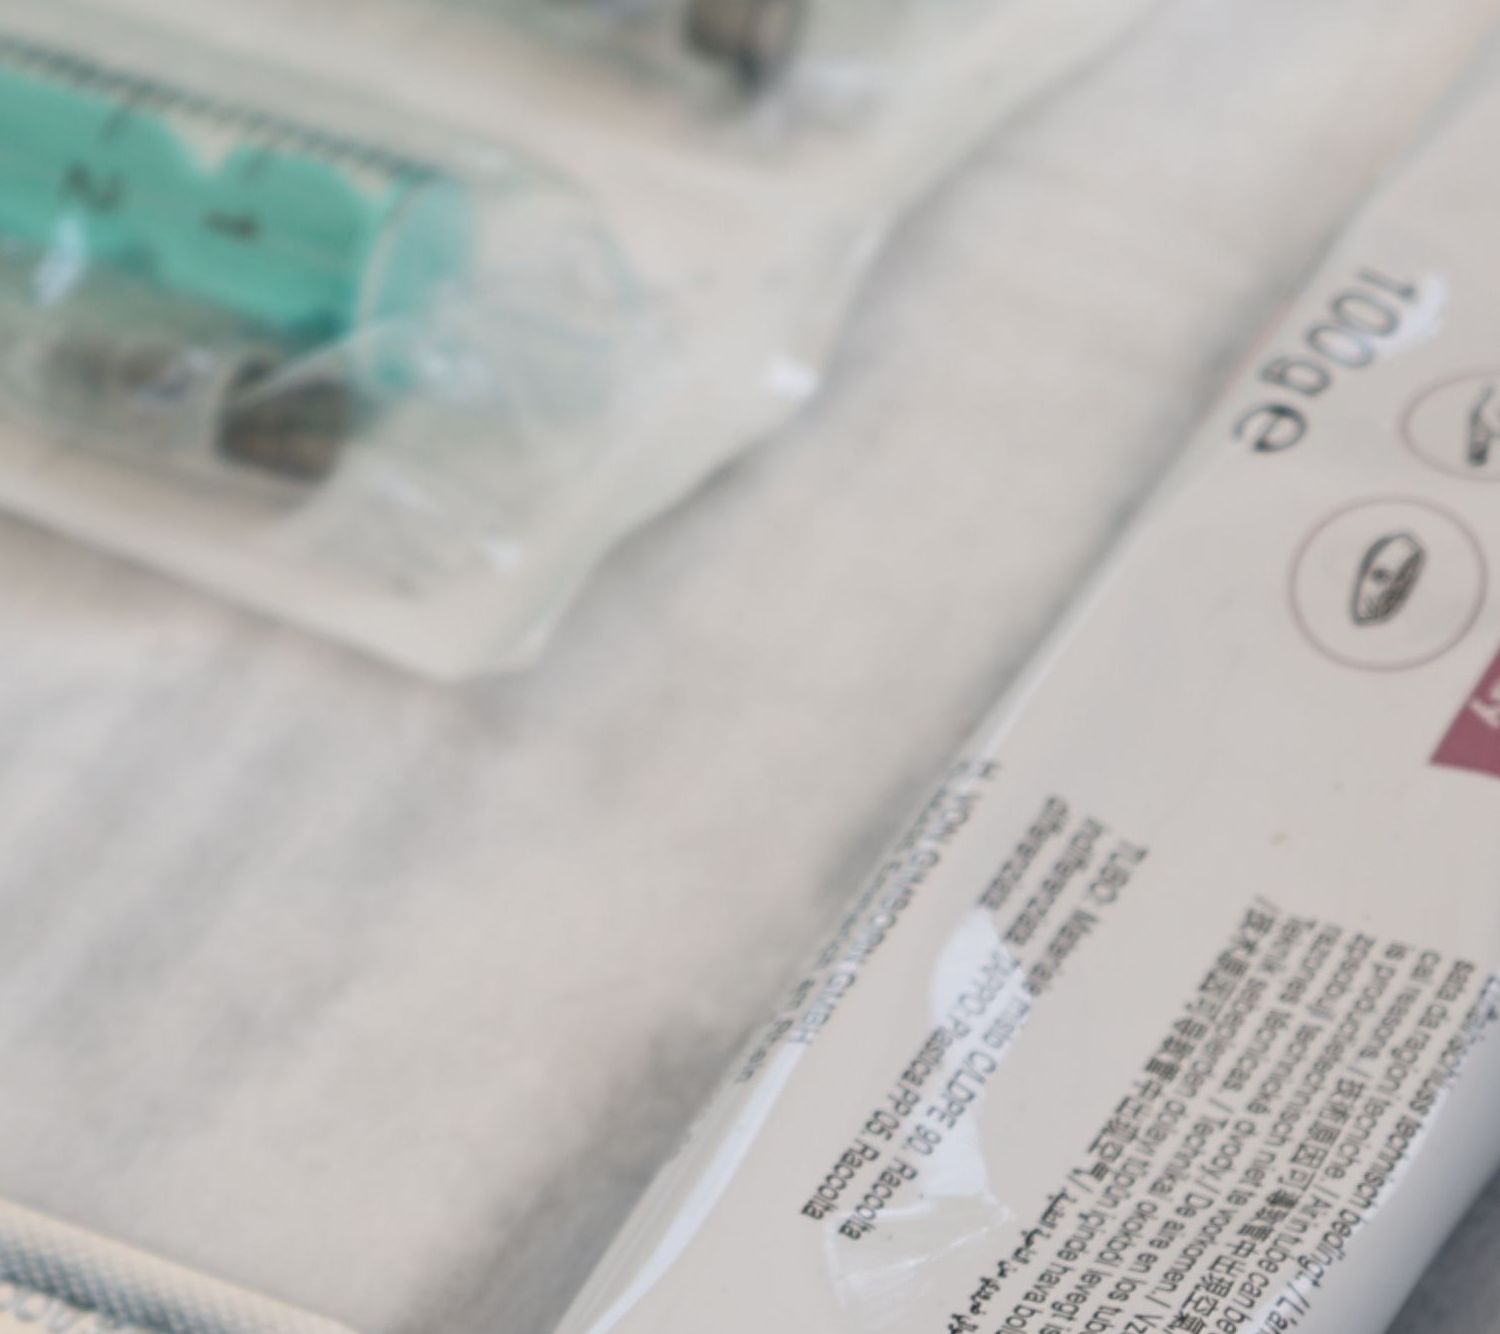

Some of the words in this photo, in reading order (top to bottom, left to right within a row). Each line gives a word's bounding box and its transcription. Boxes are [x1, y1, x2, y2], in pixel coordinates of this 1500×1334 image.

[1019, 905, 1100, 1001] Materiale
[882, 1080, 922, 1120] PP
[798, 1136, 882, 1227] Raccolta
[1350, 1113, 1426, 1212] technisch
[836, 1155, 920, 1247] Raccolta
[1173, 1187, 1216, 1223] De
[1146, 1216, 1188, 1255] aire
[1254, 1230, 1304, 1278] tube
[1021, 1259, 1074, 1311] hava
[1128, 1248, 1160, 1277] en
[1106, 1271, 1146, 1307] los
[1234, 1269, 1271, 1312] can
